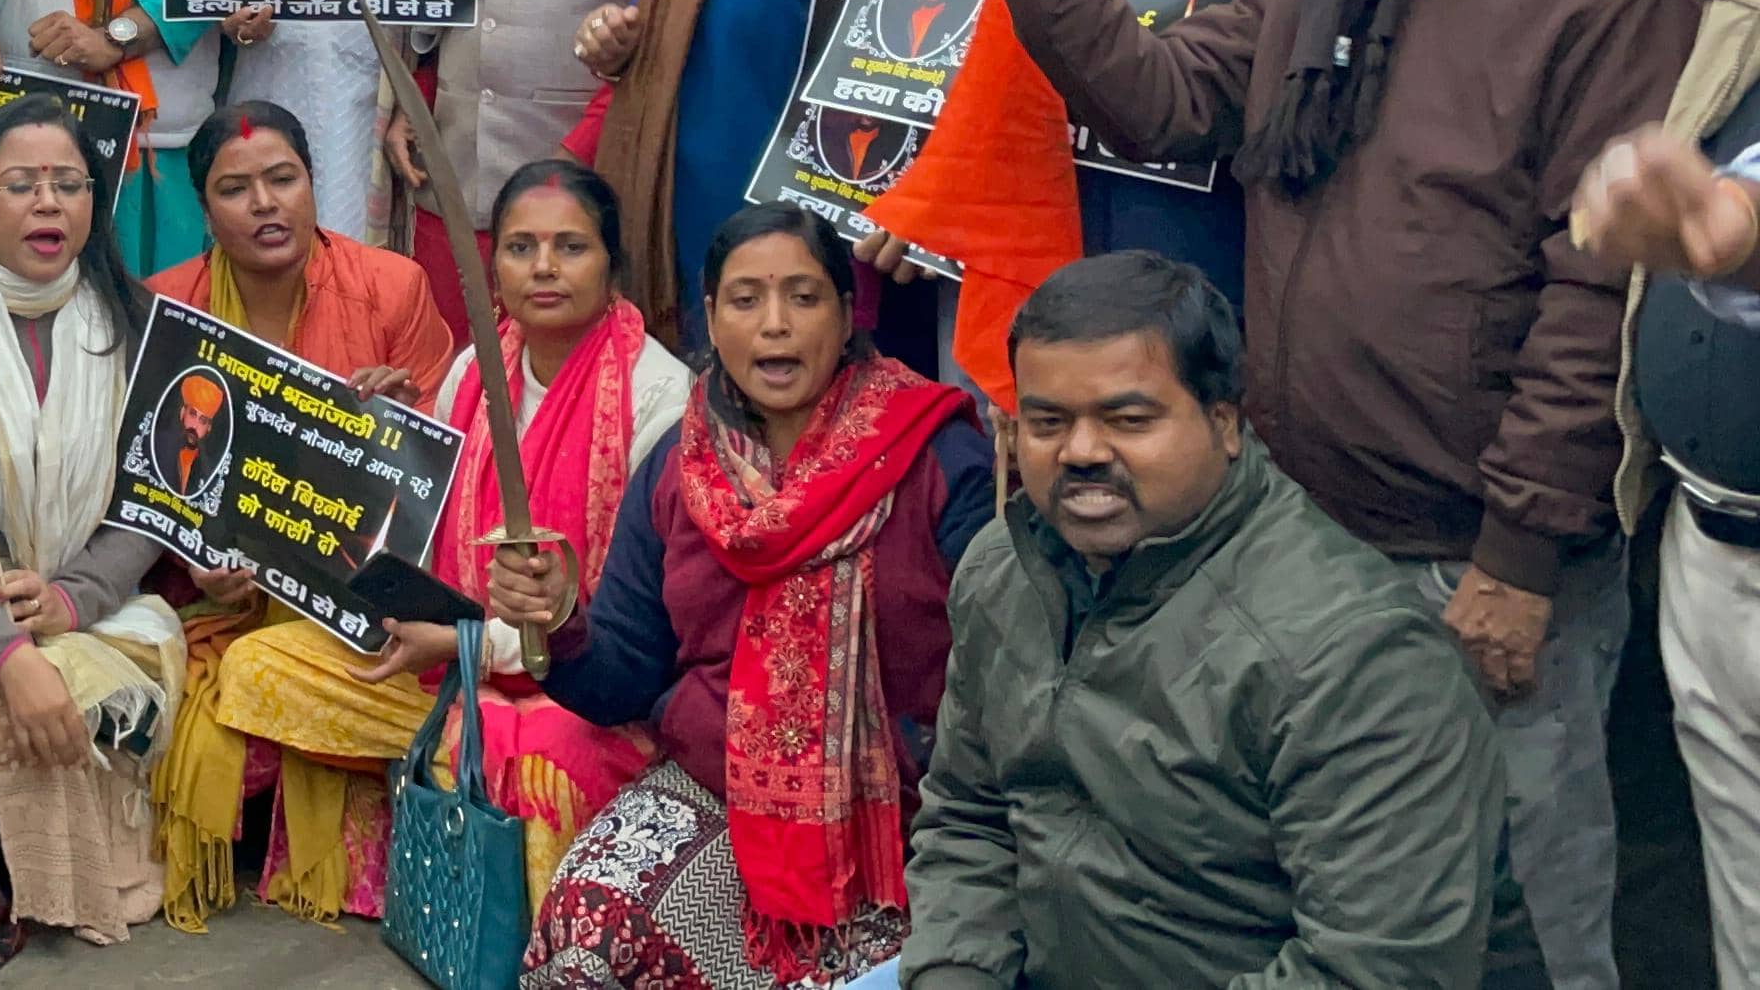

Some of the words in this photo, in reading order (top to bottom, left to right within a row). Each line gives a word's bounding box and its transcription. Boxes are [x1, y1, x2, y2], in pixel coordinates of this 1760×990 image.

[833, 77, 900, 107] हत्या
[217, 352, 283, 398] भावपूर्ण
[281, 386, 380, 440] श्रद्धांजली
[237, 493, 262, 519] को
[317, 531, 340, 557] दो
[120, 500, 175, 533] हत्या
[177, 523, 203, 556] की
[265, 568, 308, 604] CBI
[312, 593, 338, 619] से
[339, 609, 370, 639] हो
